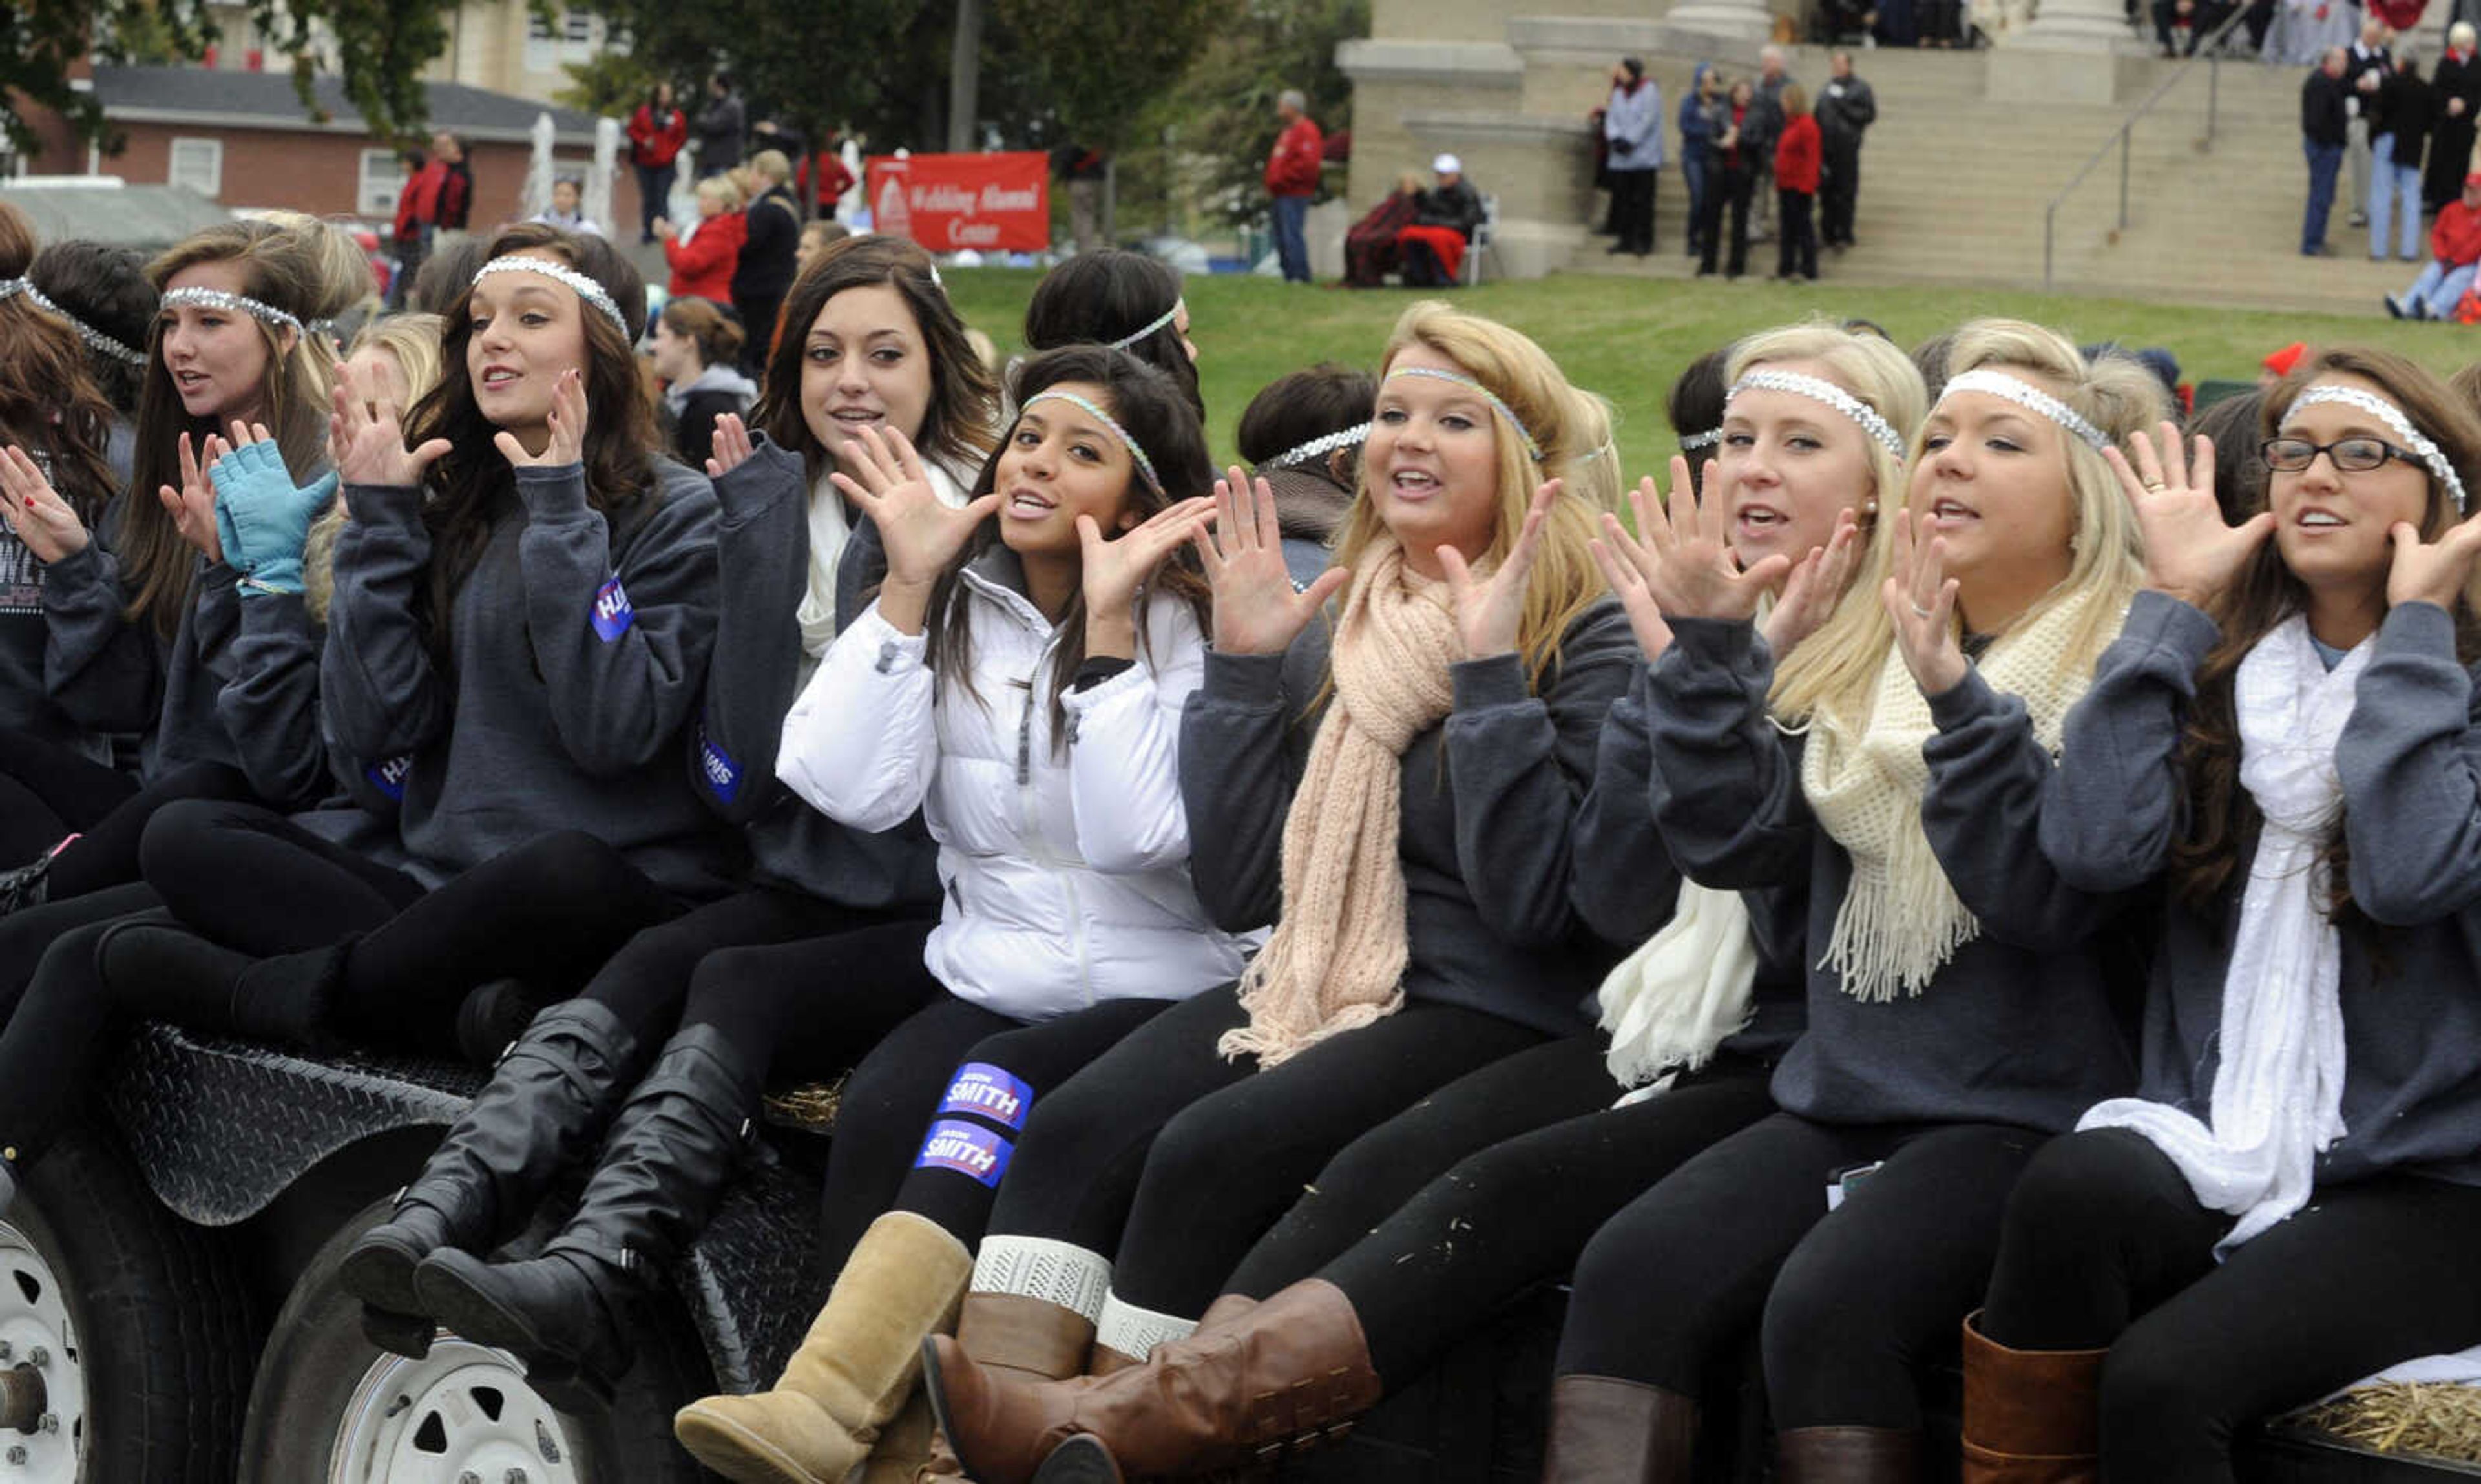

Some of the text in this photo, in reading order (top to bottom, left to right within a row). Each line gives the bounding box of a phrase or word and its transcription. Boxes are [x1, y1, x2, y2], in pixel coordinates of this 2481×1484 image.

[981, 182, 1040, 211] Alumni
[947, 217, 1000, 244] Center
[946, 1082, 1020, 1116] SMITH
[923, 1139, 996, 1171] SMITH
